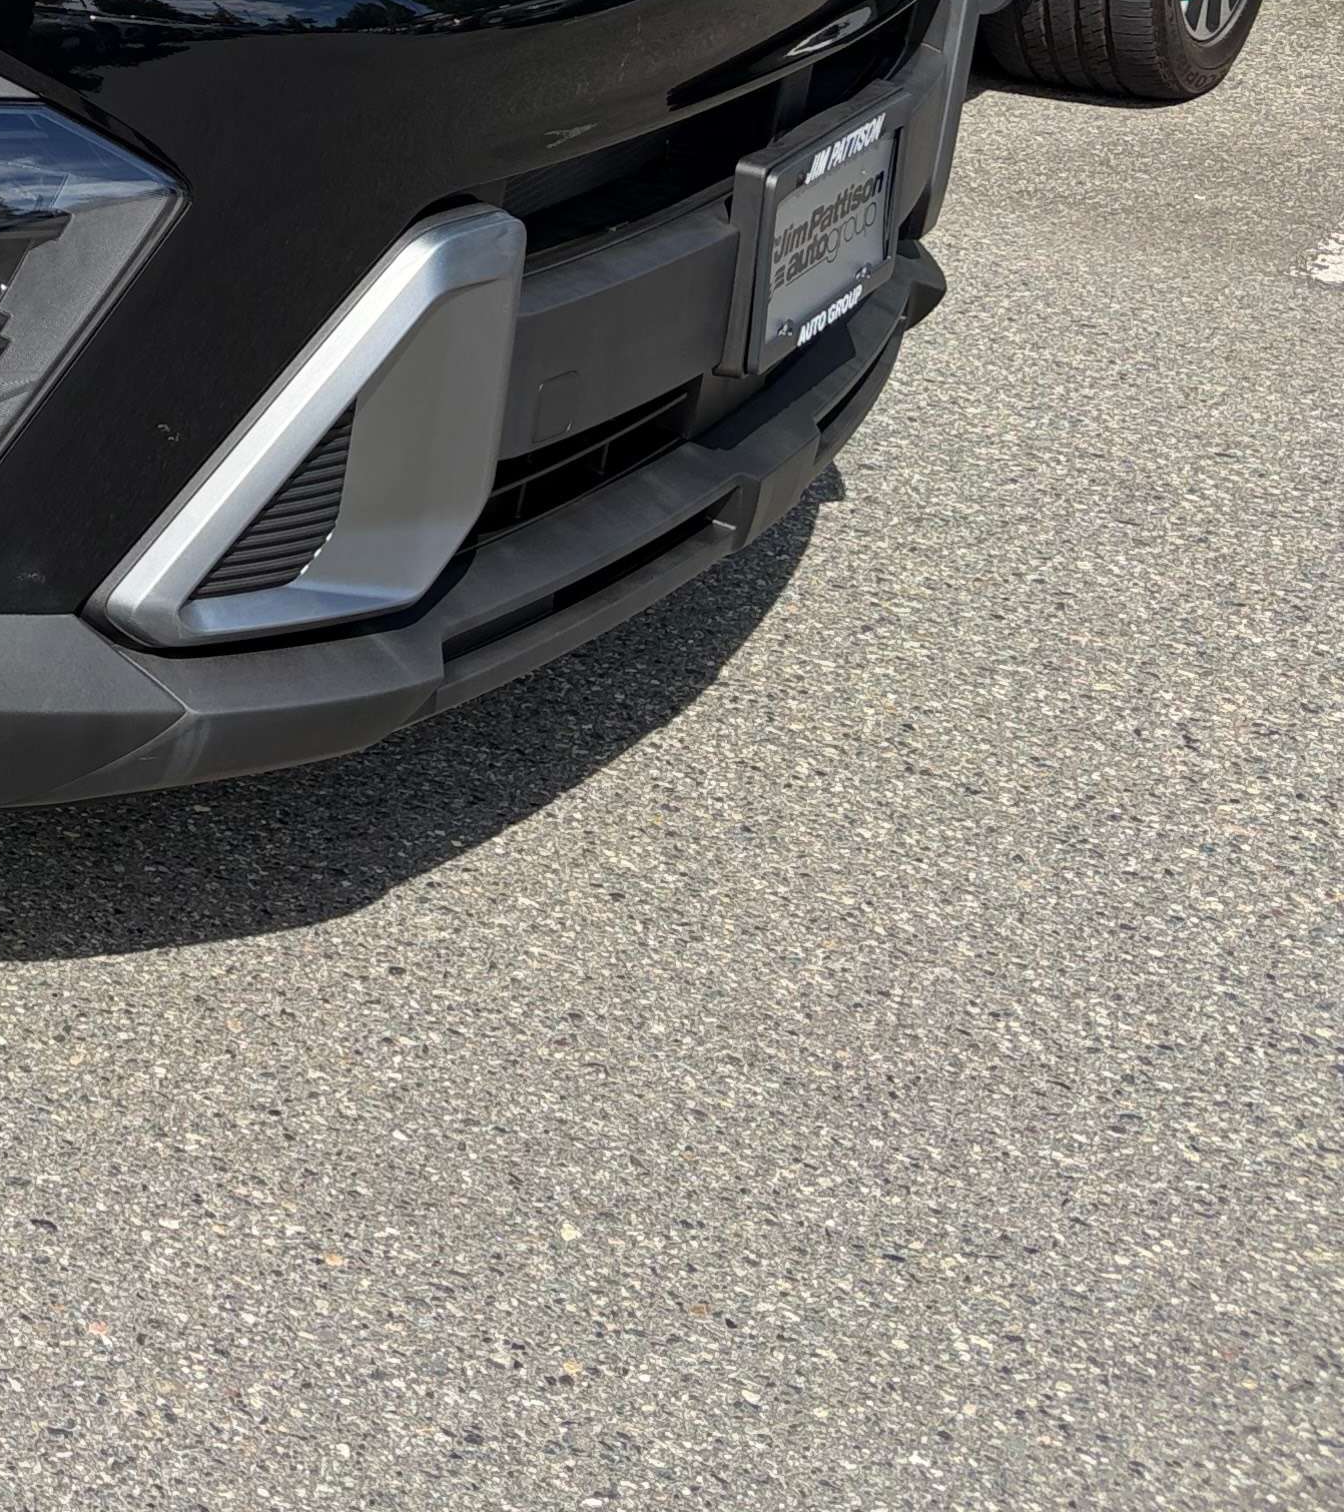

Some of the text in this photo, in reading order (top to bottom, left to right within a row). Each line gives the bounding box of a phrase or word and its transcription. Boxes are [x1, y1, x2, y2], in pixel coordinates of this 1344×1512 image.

[806, 112, 887, 185] JIM PATTISON
[797, 284, 863, 346] AUTO GROUP
